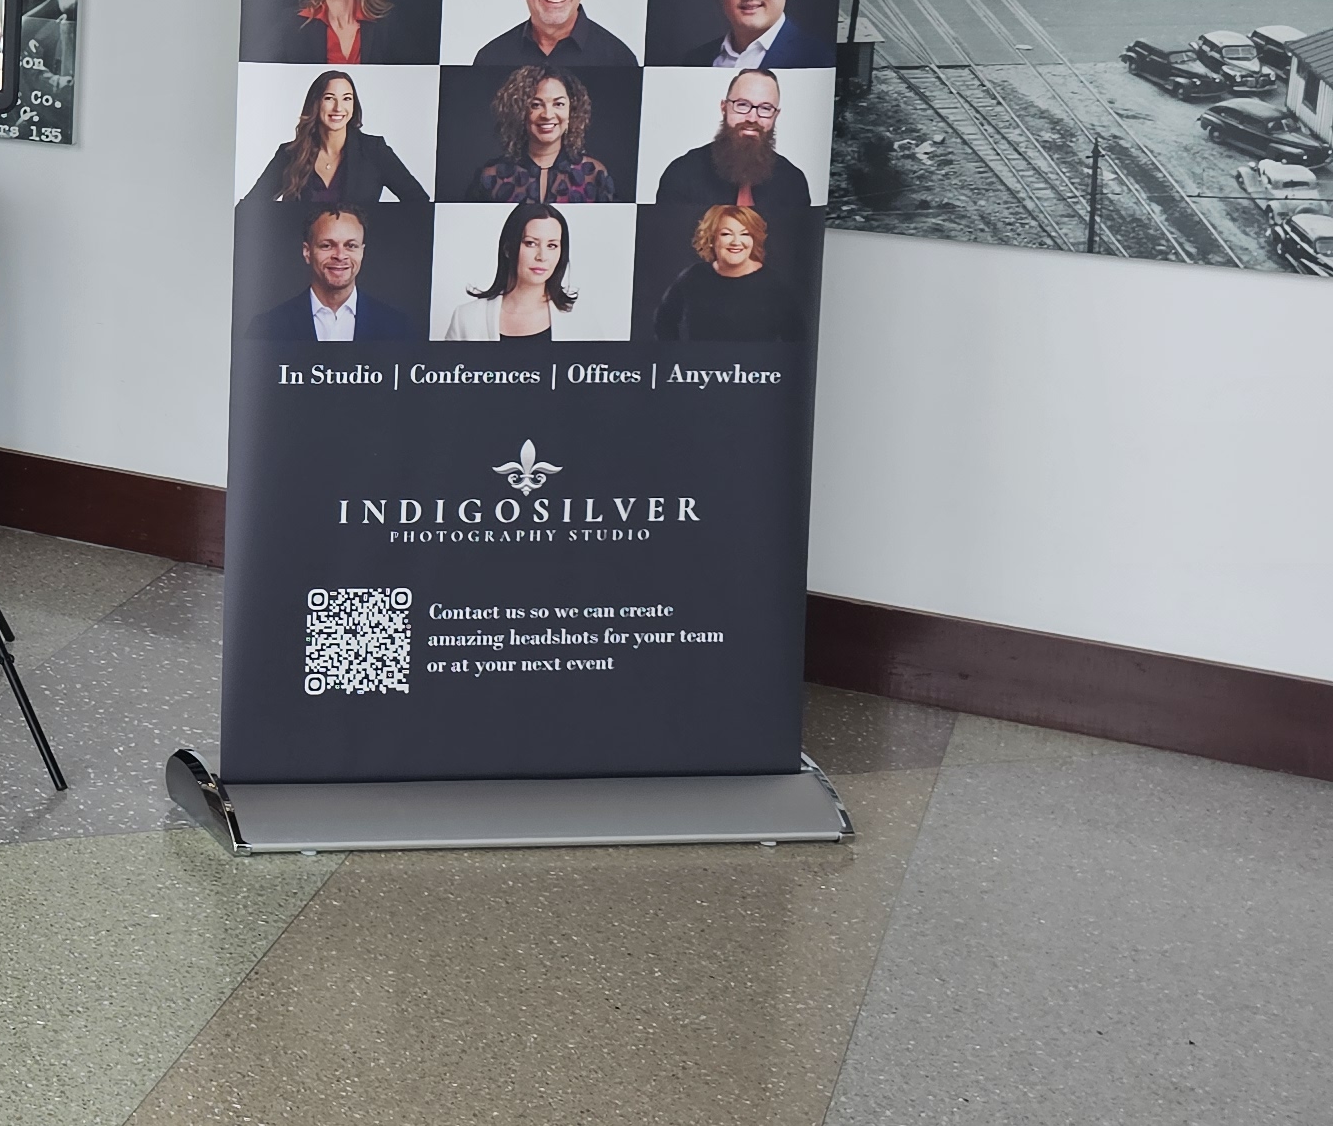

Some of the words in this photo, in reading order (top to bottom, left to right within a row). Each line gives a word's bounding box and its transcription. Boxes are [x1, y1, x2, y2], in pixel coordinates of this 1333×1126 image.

[30, 90, 62, 109] Co.
[28, 125, 63, 143] 135
[277, 364, 305, 385] In
[310, 364, 383, 385] Studio
[410, 363, 541, 385] Conferences
[567, 363, 642, 385] Offices
[666, 363, 782, 390] Anywhere
[338, 497, 702, 525] INDIGOSILVER
[389, 529, 558, 544] PHOTOGRAPHY
[568, 528, 651, 542] STUDIO
[428, 603, 501, 620] Contact
[505, 608, 526, 620] us
[529, 608, 550, 620] so
[553, 607, 579, 619] we
[583, 606, 615, 619] can
[619, 604, 674, 618] create
[427, 630, 505, 651] amazing
[509, 628, 599, 646] headshots
[603, 628, 629, 644] for
[632, 634, 676, 649] your
[679, 630, 724, 643] team
[426, 661, 447, 673] or
[450, 659, 470, 673] at
[474, 659, 517, 678] your
[521, 657, 562, 672] next
[566, 657, 615, 671] event
